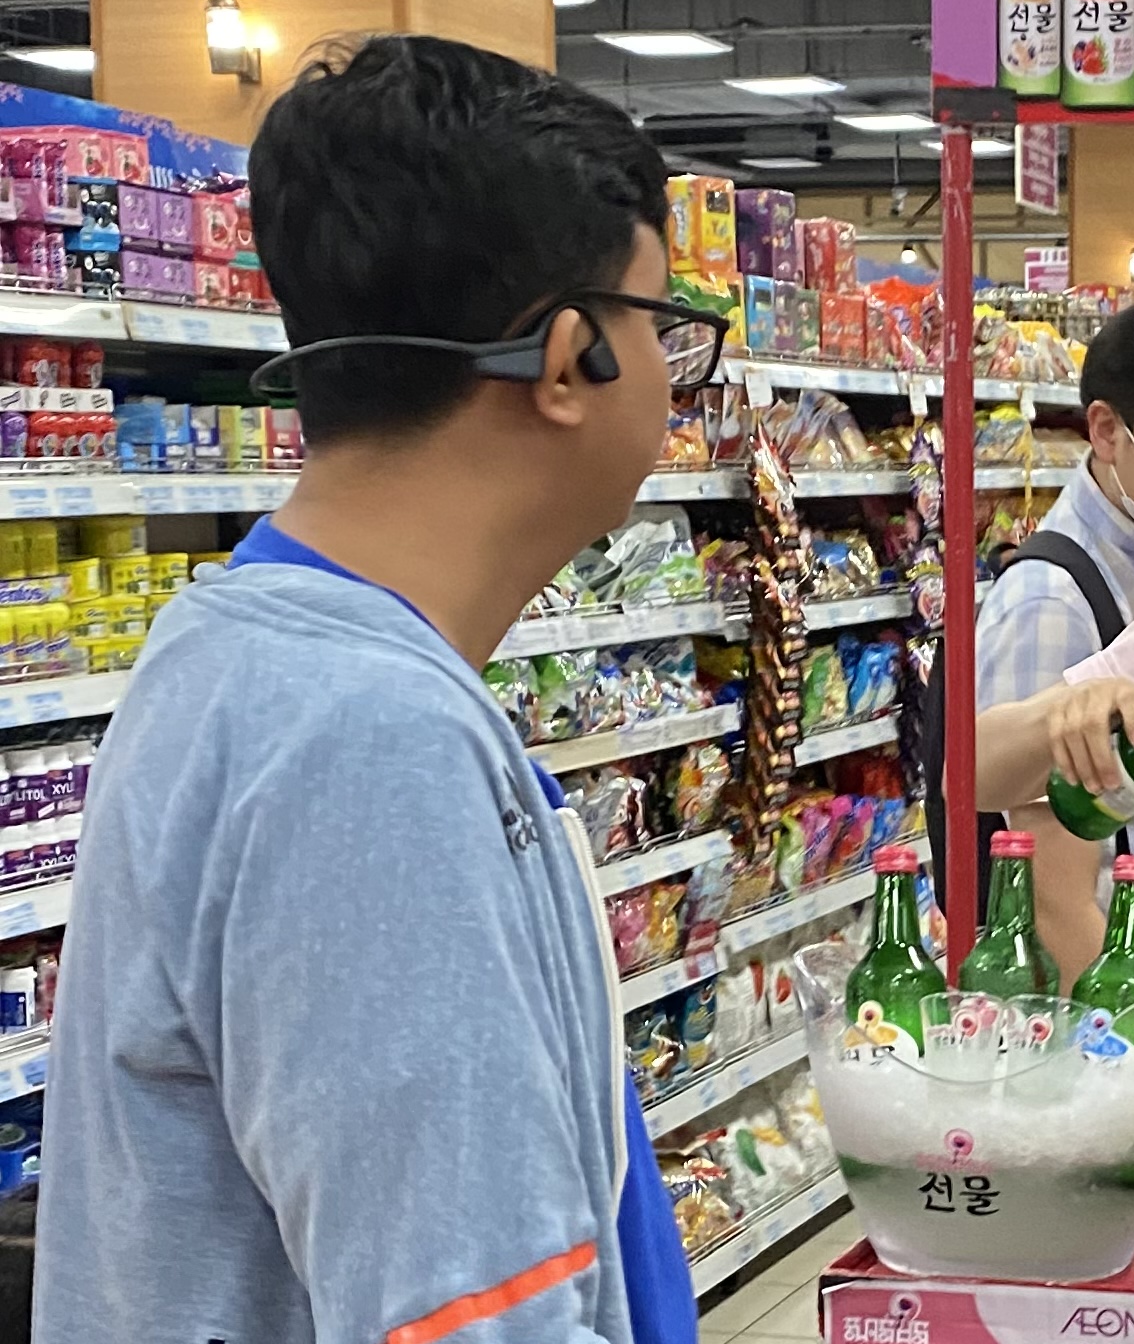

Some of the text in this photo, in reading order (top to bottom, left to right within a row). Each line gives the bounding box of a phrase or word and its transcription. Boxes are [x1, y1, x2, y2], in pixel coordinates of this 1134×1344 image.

[1008, 3, 1056, 33] 선물
[1074, 0, 1133, 33] 선물
[919, 1172, 1000, 1216] 선물
